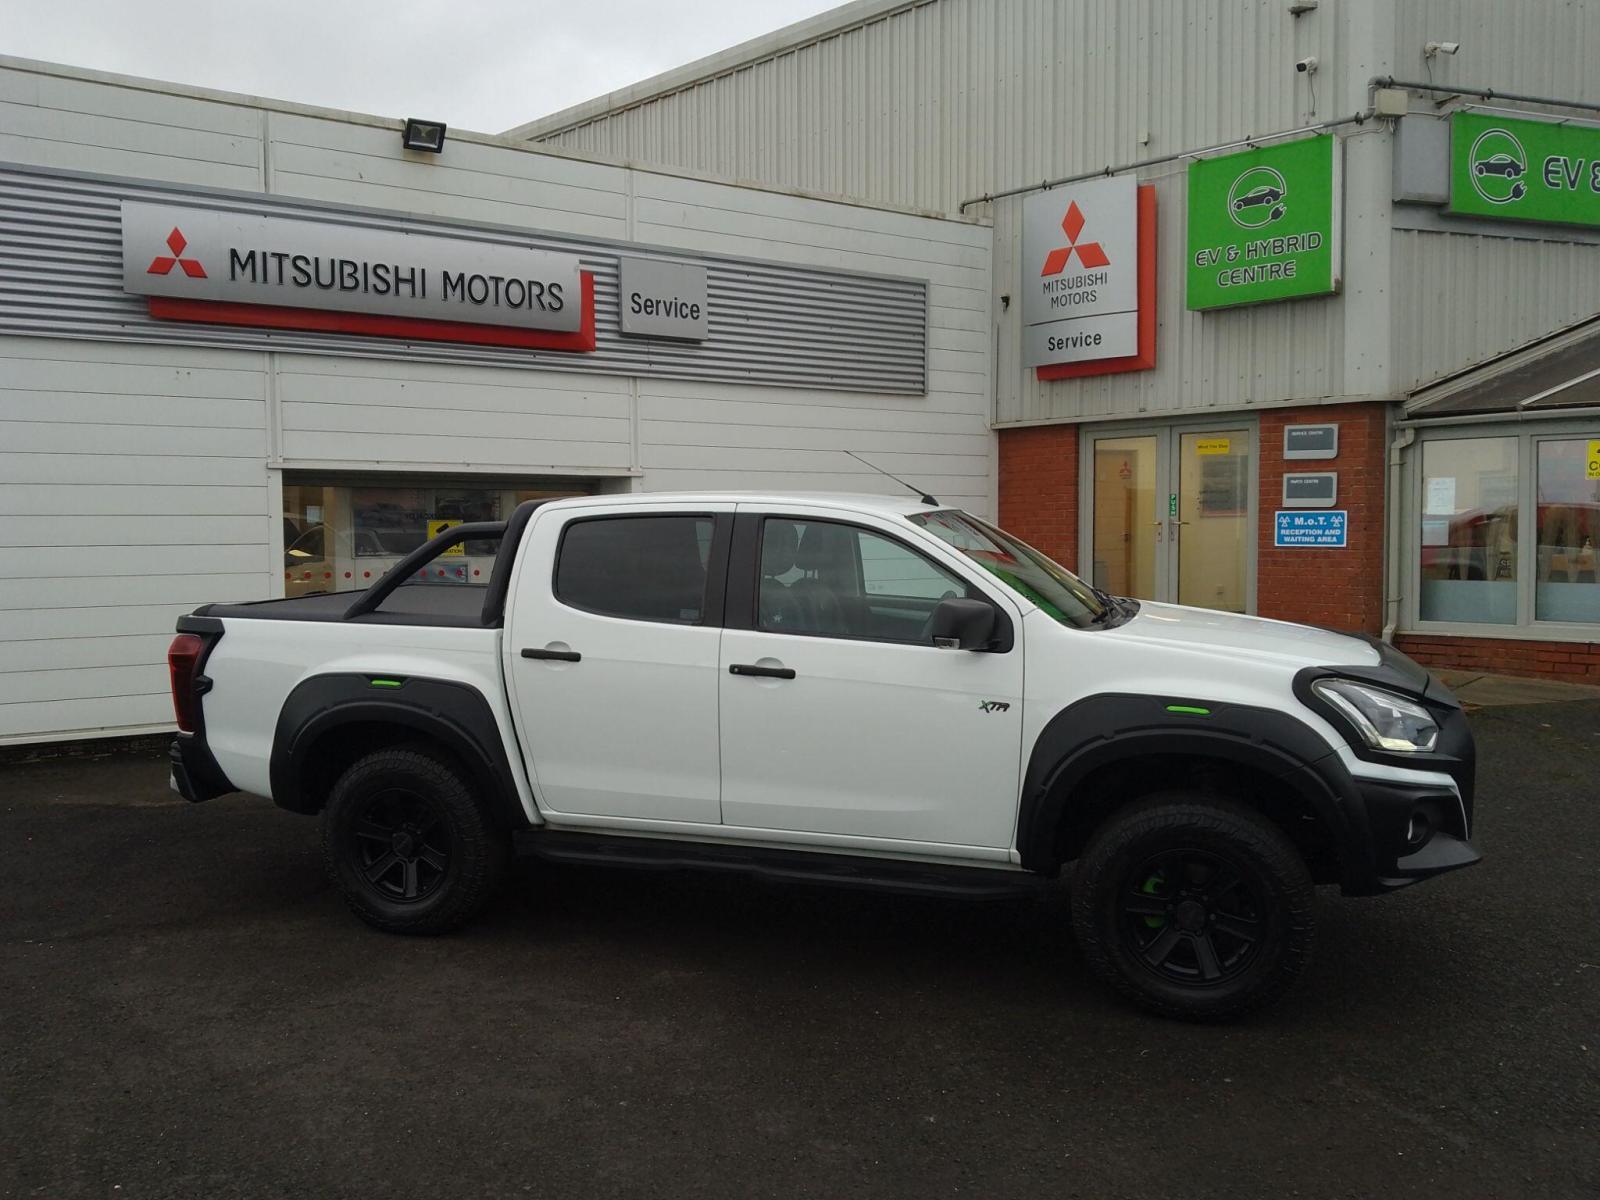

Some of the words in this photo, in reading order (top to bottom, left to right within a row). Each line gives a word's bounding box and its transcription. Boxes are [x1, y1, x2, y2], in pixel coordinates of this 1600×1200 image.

[1543, 155, 1585, 190] EV
[1195, 247, 1221, 267] EV
[1226, 245, 1240, 263] &
[1246, 232, 1322, 260] HYBRID
[230, 247, 426, 299] MITSUBISHI
[442, 270, 563, 312] MOTORS
[1043, 272, 1108, 295] MITSUBISHI
[1218, 260, 1296, 287] CENTRE
[630, 292, 700, 321] Service
[1050, 289, 1097, 309] MOTORS
[1047, 331, 1102, 352] Service
[1294, 516, 1327, 526] M.o.T.
[1324, 528, 1342, 536] AND
